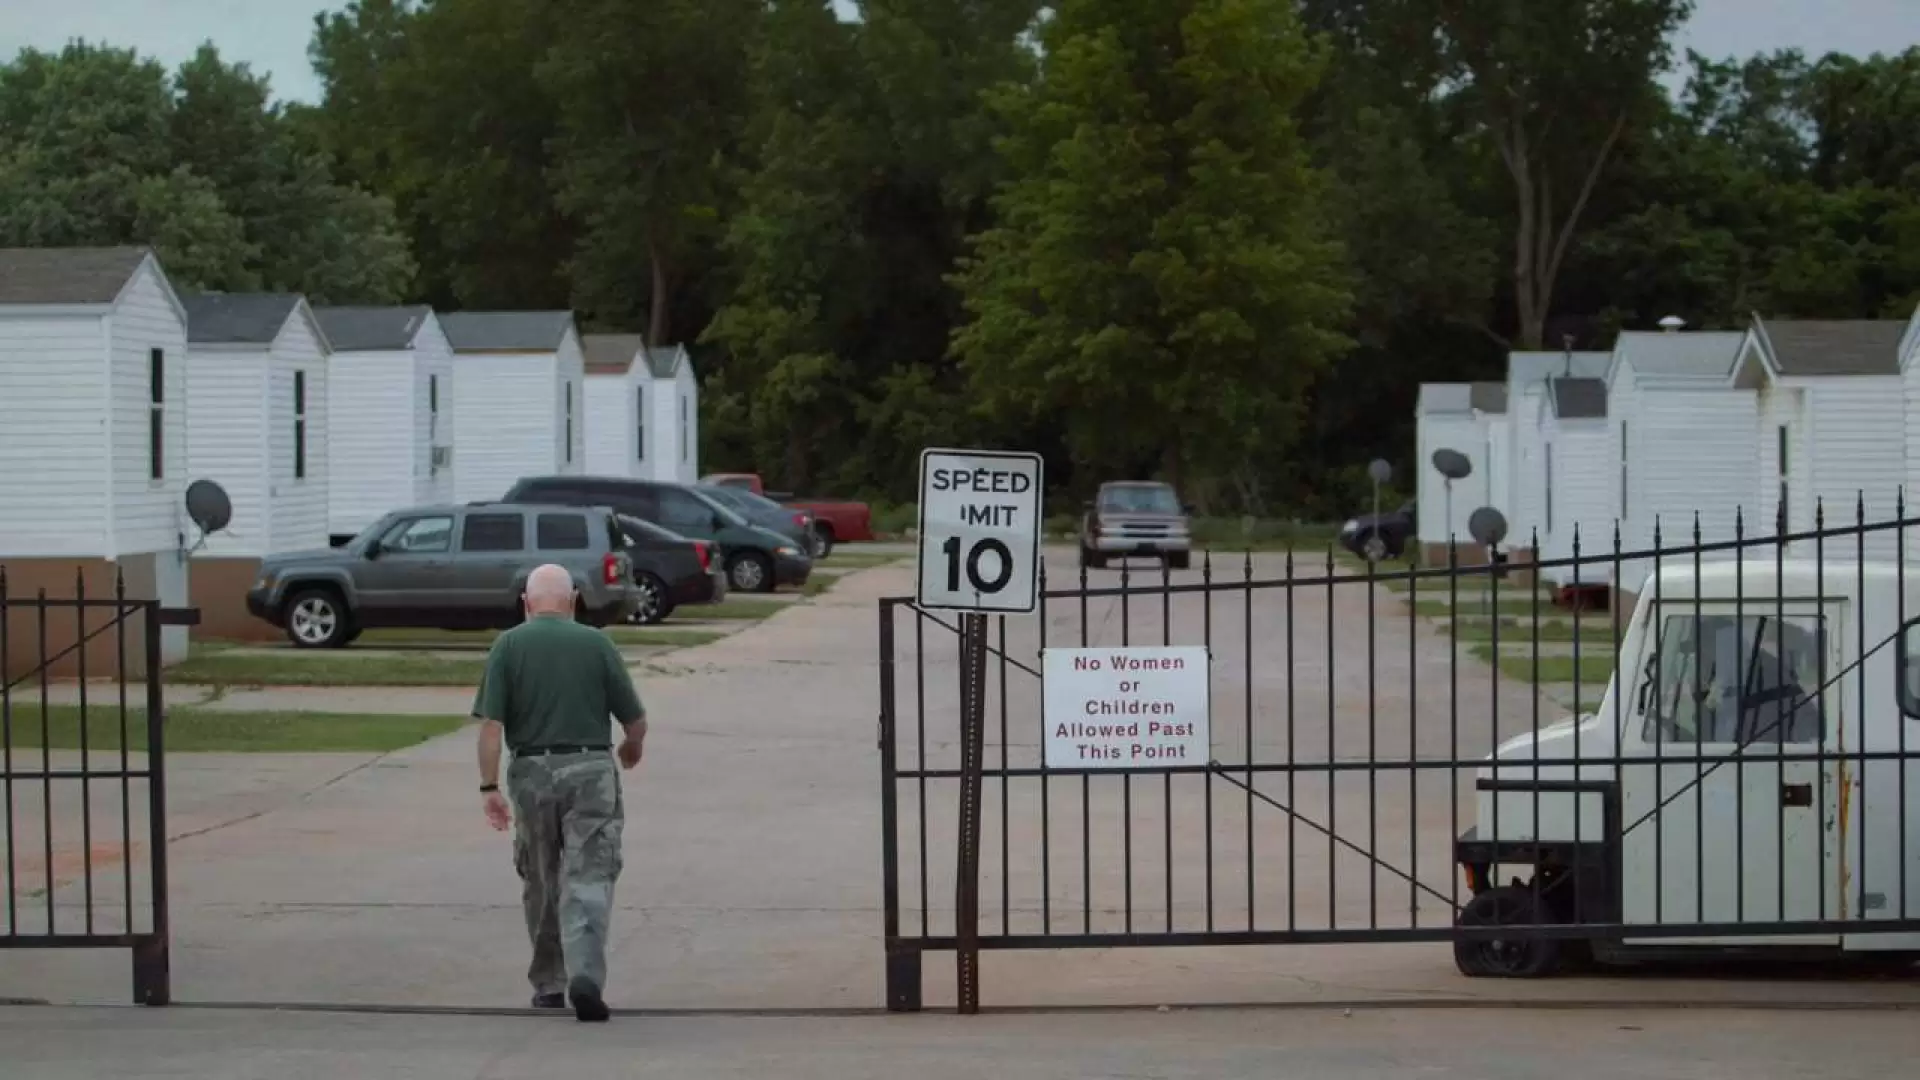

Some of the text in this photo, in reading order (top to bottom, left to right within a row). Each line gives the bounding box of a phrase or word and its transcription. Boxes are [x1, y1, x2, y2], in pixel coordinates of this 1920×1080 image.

[932, 469, 1030, 493] SPEED
[959, 503, 1018, 526] IMIT
[943, 536, 1013, 593] 10
[1074, 656, 1185, 670] No Women
[1119, 681, 1140, 692] or
[1085, 700, 1174, 715] Children
[1056, 722, 1194, 738] Allowed Past
[1077, 744, 1186, 759] This Point
